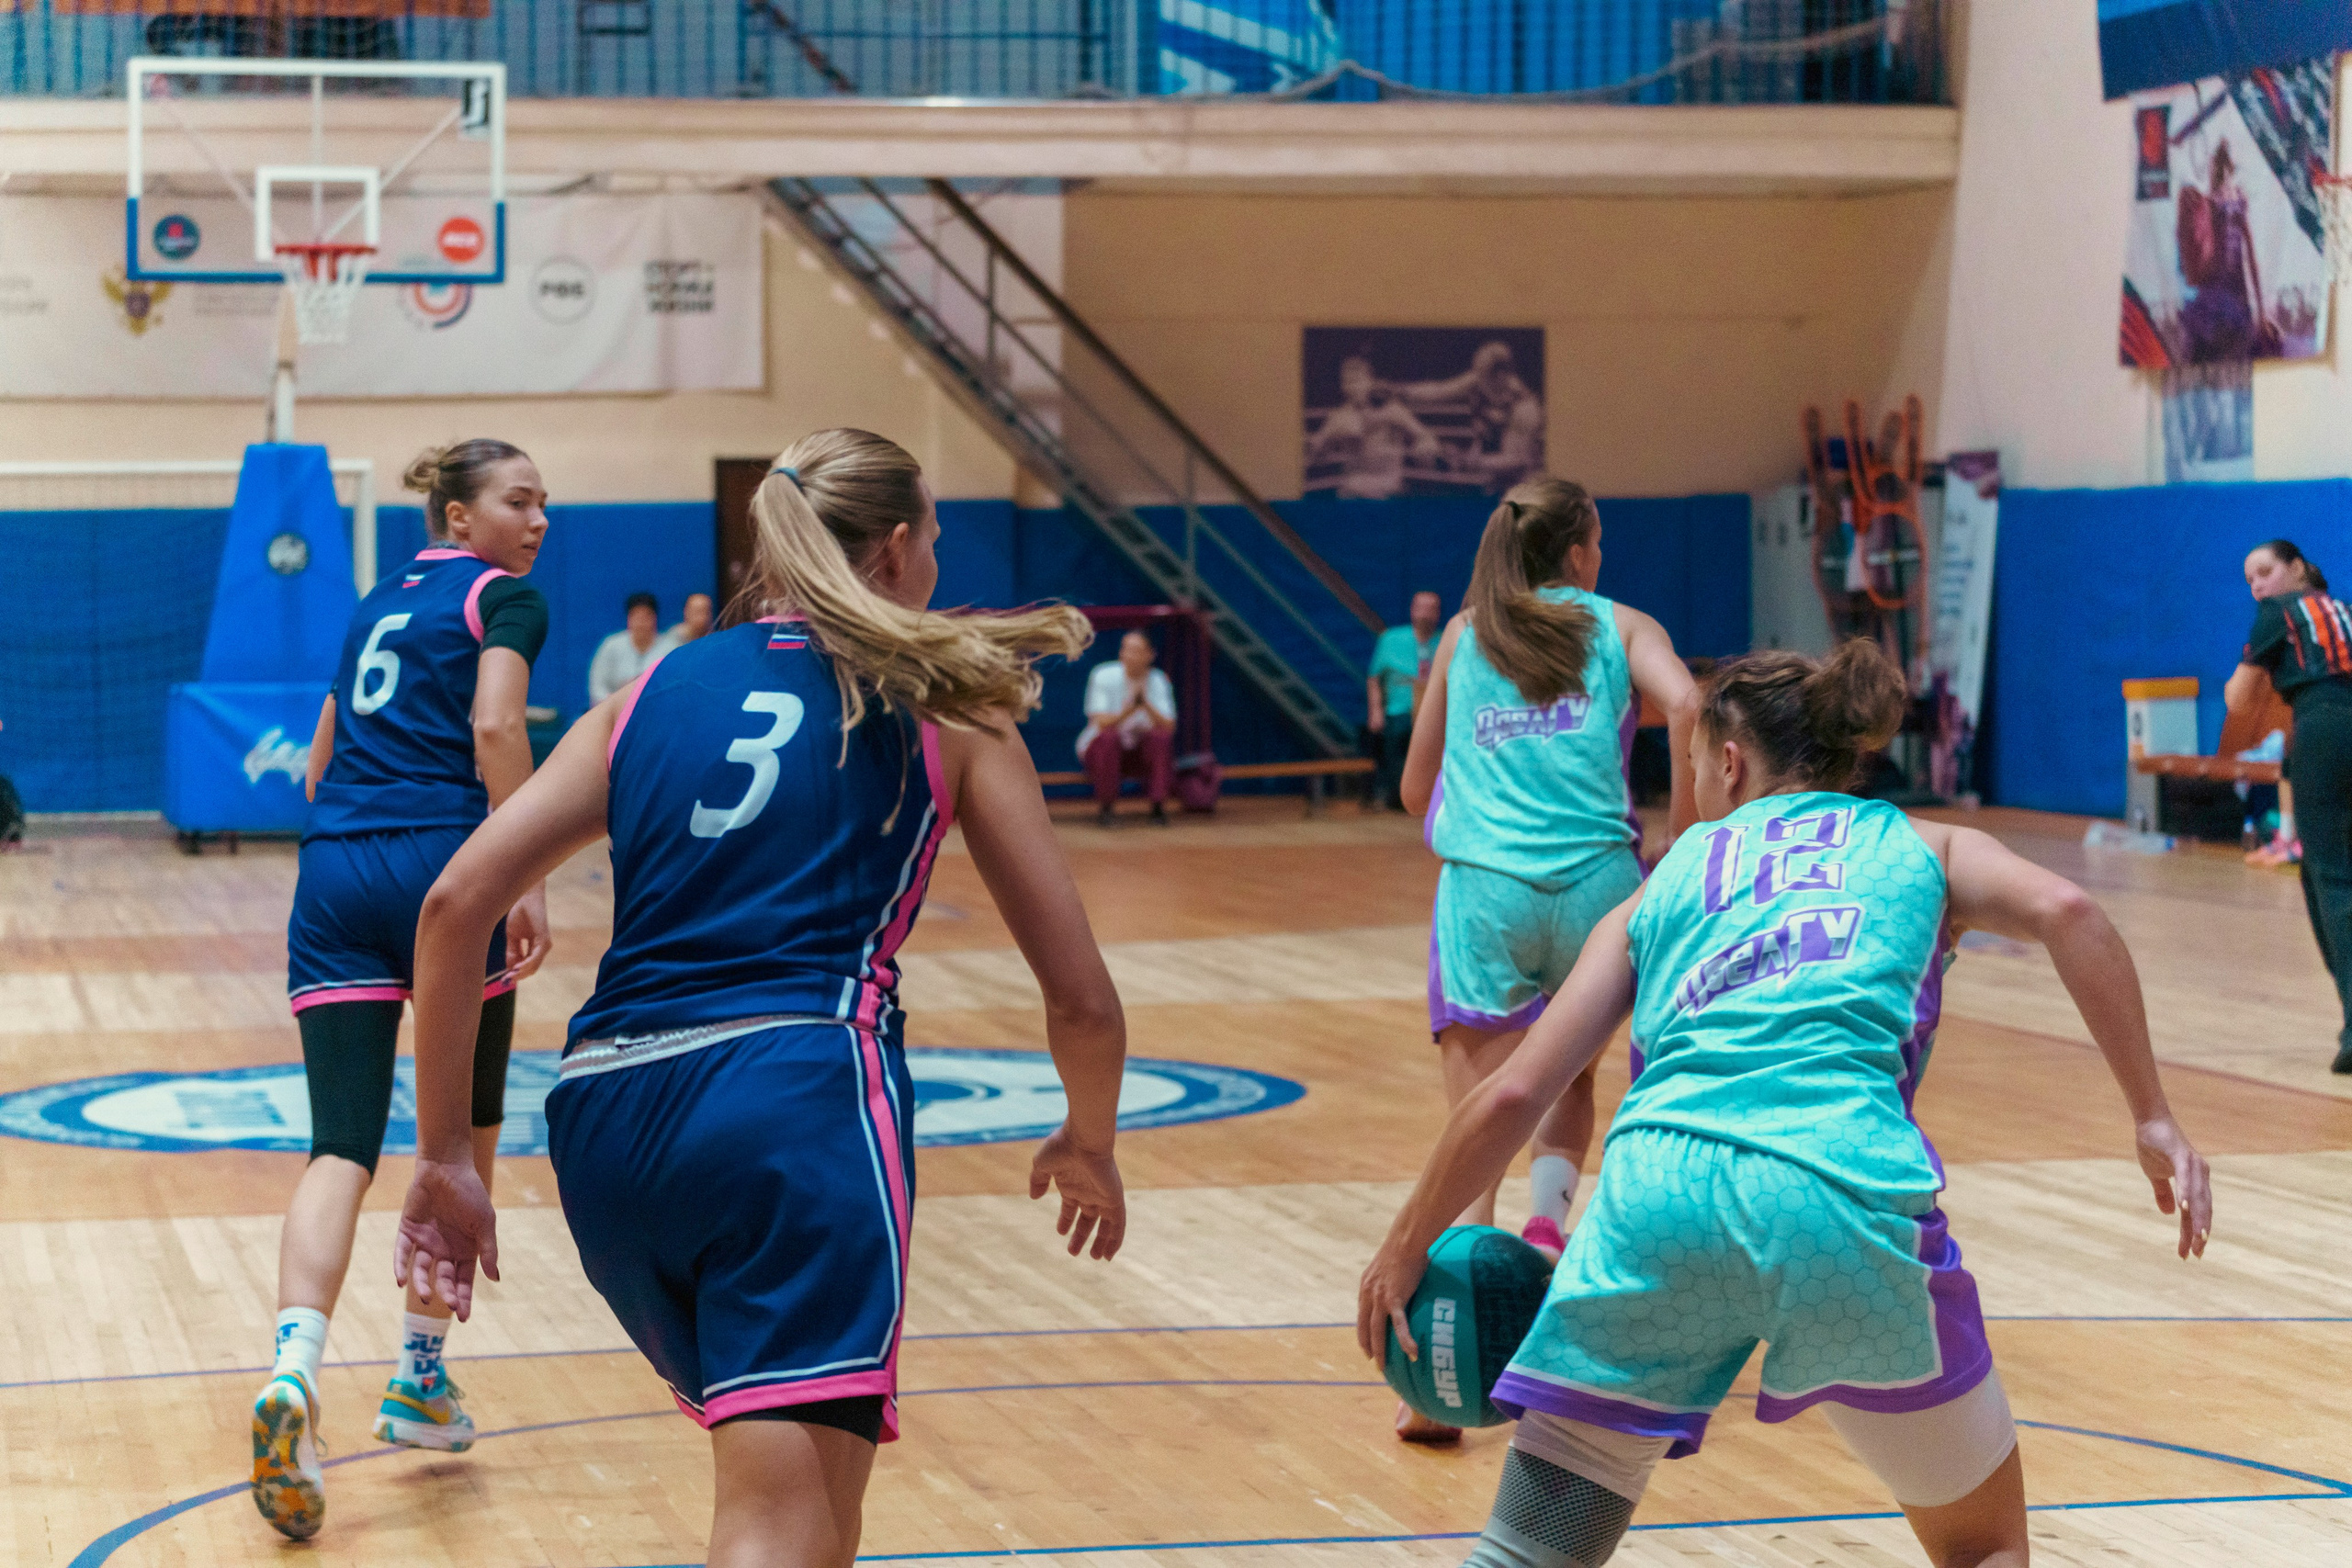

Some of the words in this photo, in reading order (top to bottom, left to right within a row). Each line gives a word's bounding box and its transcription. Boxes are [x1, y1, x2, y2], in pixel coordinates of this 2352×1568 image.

[352, 612, 413, 716] 6
[689, 691, 805, 839] 3
[1703, 807, 1852, 916] 12
[1431, 1296, 1463, 1408] СИБУР
